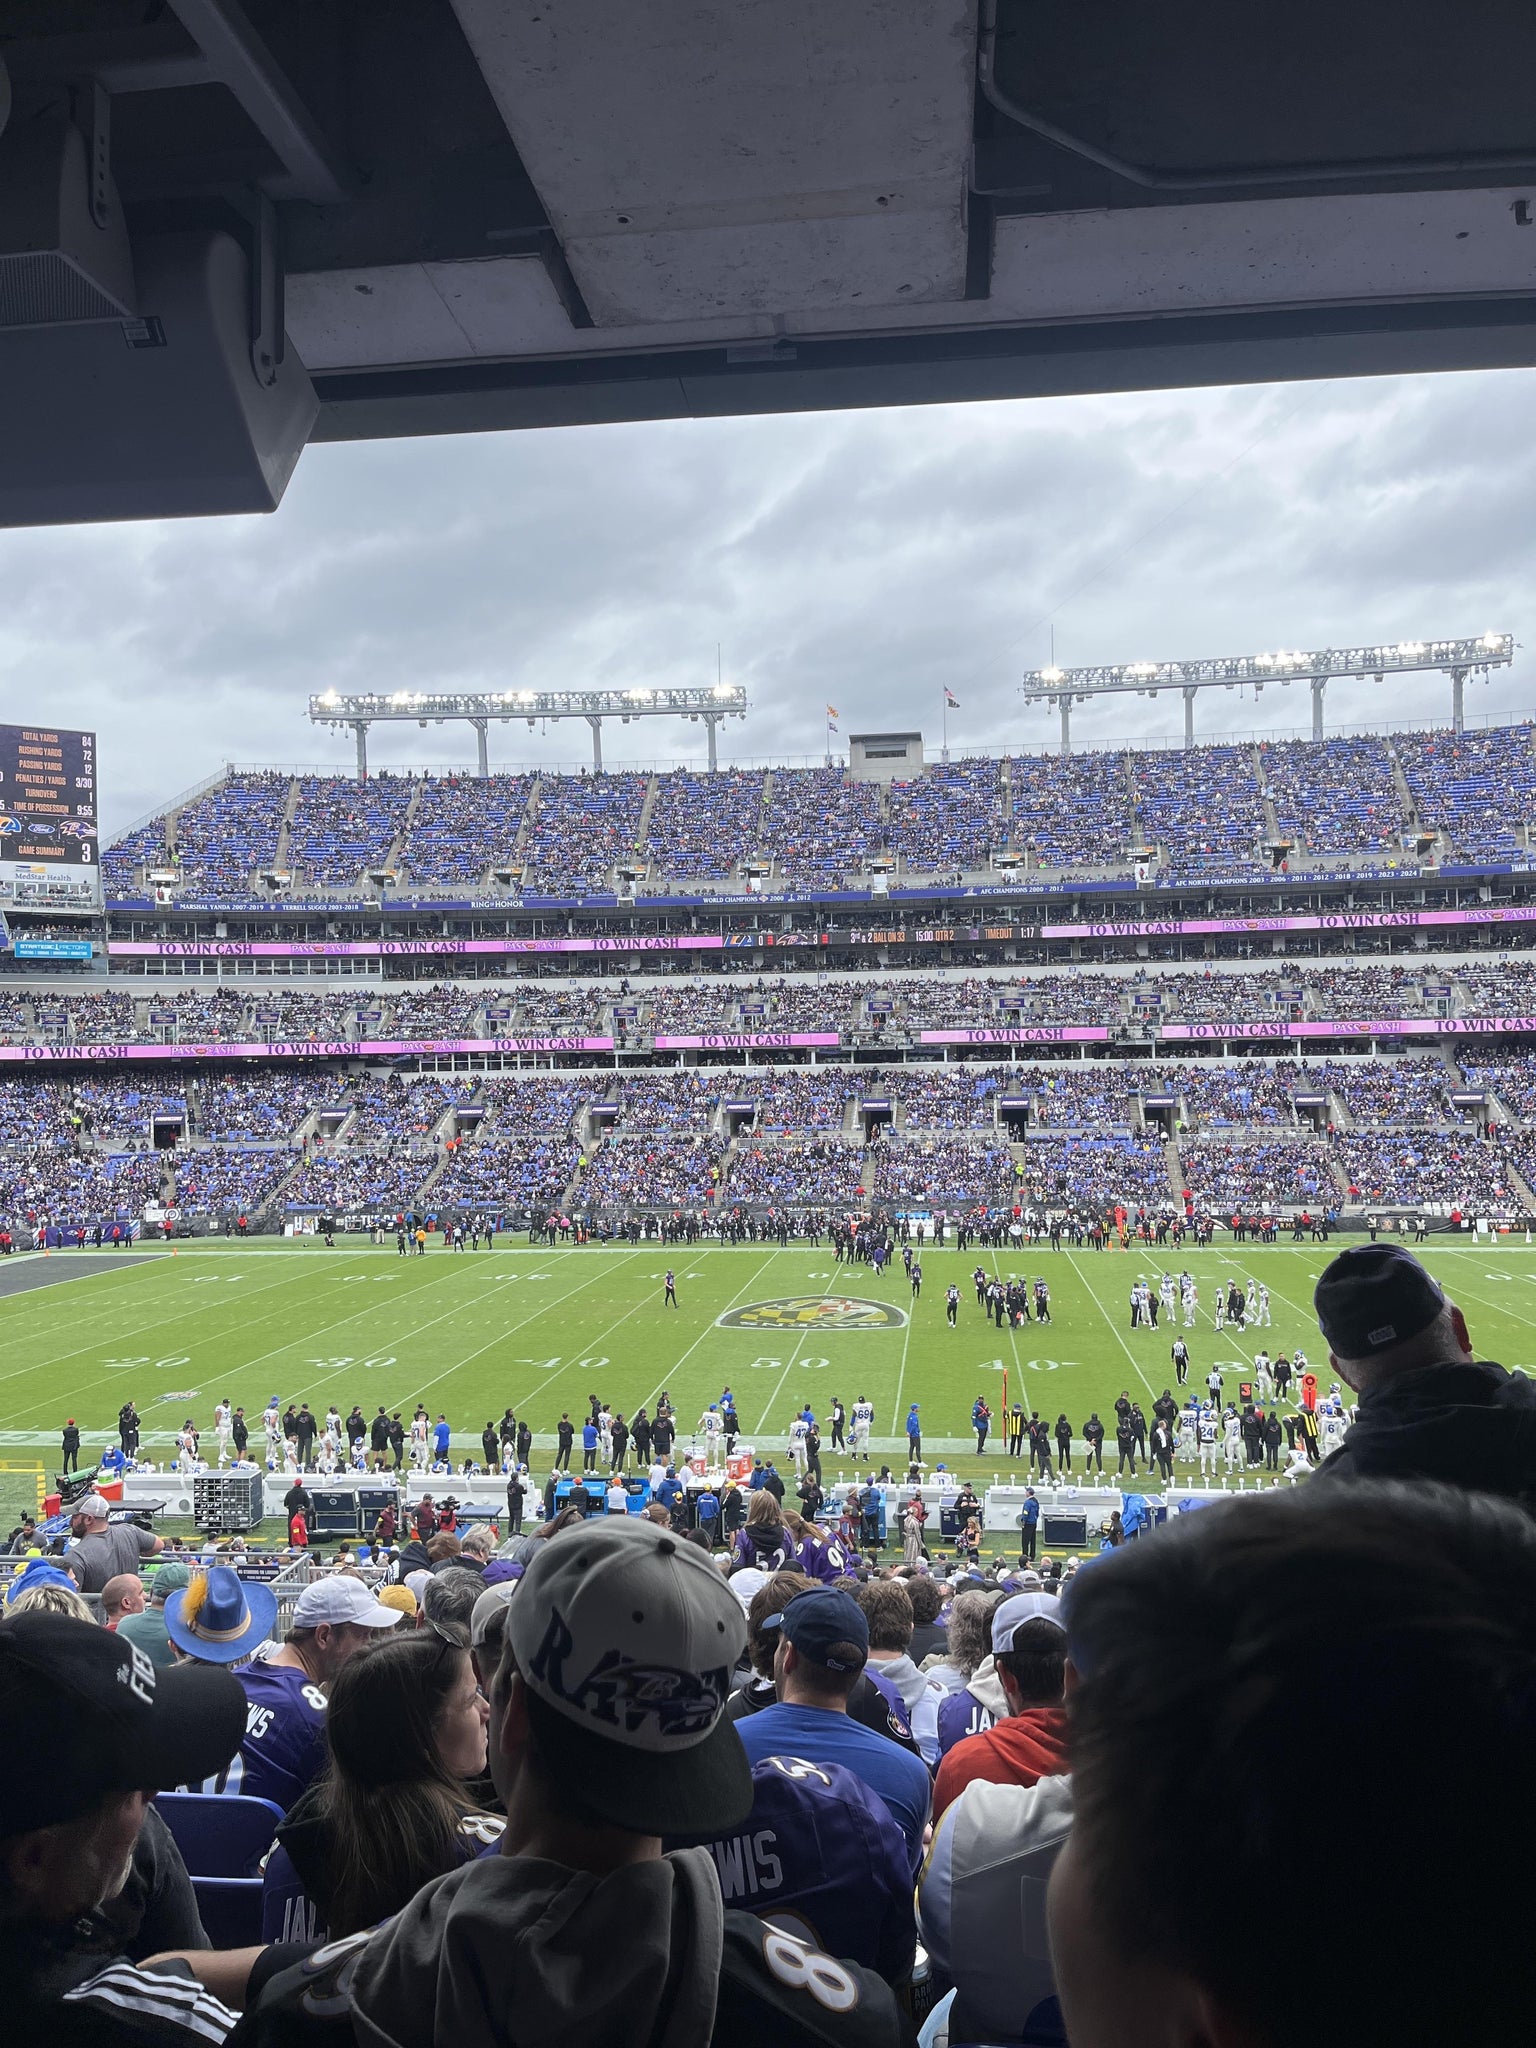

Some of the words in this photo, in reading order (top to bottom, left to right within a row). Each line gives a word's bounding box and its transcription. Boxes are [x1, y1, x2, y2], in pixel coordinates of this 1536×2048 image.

[22, 731, 39, 741] TOTAL
[40, 733, 58, 743] YARDS
[82, 736, 92, 747] 84
[18, 745, 43, 756] RUSHING
[43, 748, 62, 758] YARDS
[83, 750, 92, 761] 72
[19, 760, 43, 770] PASSING
[44, 761, 62, 771] YARDS
[84, 764, 92, 775] 12
[15, 773, 44, 784] PENALTIES
[48, 776, 66, 785] YARDS
[75, 777, 92, 788] 3/30
[25, 788, 57, 799] TURNOVERS
[89, 792, 93, 802] 1
[13, 801, 27, 811] TIME
[27, 803, 35, 811] OF
[35, 803, 69, 813] POSSESSION
[76, 804, 93, 816] 9:55
[18, 845, 35, 855] GAME
[35, 846, 65, 856] SUMMARY
[81, 843, 91, 862] 3
[1511, 863, 1529, 872] THANK
[1188, 879, 1210, 887] NORTH
[1210, 877, 1248, 885] CHAMPIONS
[1249, 876, 1265, 884] 2003
[494, 900, 524, 908] HONOR
[1465, 911, 1493, 921] PASS
[1502, 909, 1535, 919] CASH
[1223, 920, 1249, 931] PASS
[1257, 919, 1287, 929] CASH
[1317, 916, 1338, 928] TO
[1342, 915, 1375, 927] WIN
[1379, 914, 1420, 925] CASH
[985, 928, 1013, 940] TIMEOUT
[1020, 926, 1035, 938] 1:17
[1087, 925, 1107, 936] TO
[1110, 923, 1141, 935] WIN
[1145, 922, 1183, 934] CASH
[758, 935, 764, 946] 0
[812, 934, 818, 945] 3
[850, 932, 861, 944] 3rd
[867, 931, 873, 943] 2
[873, 931, 887, 943] BALL
[887, 931, 897, 943] ON
[897, 931, 905, 943] 33
[915, 930, 933, 942] 15:00
[935, 930, 948, 941] QTR
[949, 929, 955, 941] 2
[156, 943, 176, 954] TO
[180, 944, 211, 954] WIN
[216, 944, 253, 954] CASH
[291, 944, 315, 953] PASS
[323, 945, 350, 954] CASH
[377, 942, 395, 953] TO
[395, 942, 428, 953] WIN
[431, 942, 466, 953] CASH
[504, 942, 526, 951] PASS
[535, 941, 561, 951] CASH
[591, 939, 609, 950] TO
[614, 939, 641, 949] WIN
[644, 938, 679, 949] CASH
[1186, 1025, 1207, 1037] TO
[1211, 1025, 1244, 1036] WIN
[1249, 1024, 1290, 1036] CASH
[1332, 1024, 1360, 1033] PASS
[1369, 1022, 1402, 1032] CASH
[1434, 1021, 1457, 1032] TO
[1462, 1020, 1497, 1031] WIN
[1501, 1018, 1536, 1031] CAS
[699, 1036, 718, 1047] TO
[721, 1035, 751, 1046] WIN
[755, 1034, 792, 1046] CASH
[966, 1030, 986, 1041] TO
[990, 1030, 1021, 1041] WIN
[1025, 1029, 1064, 1040] CASH
[265, 1044, 286, 1055] TO
[290, 1043, 320, 1054] WIN
[324, 1043, 361, 1054] CASH
[402, 1043, 425, 1052] PASS
[433, 1042, 461, 1051] CASH
[492, 1040, 512, 1050] TO
[515, 1039, 545, 1050] WIN
[549, 1039, 585, 1050] CASH
[21, 1047, 44, 1059] TO
[48, 1047, 83, 1058] WIN
[87, 1046, 129, 1058] CASH
[171, 1046, 197, 1055] PASS
[206, 1046, 235, 1055] CASH
[104, 1356, 191, 1367] 20
[316, 1356, 397, 1368] 30
[532, 1357, 610, 1368] 40
[750, 1357, 830, 1368] 50
[978, 1359, 1059, 1371] 40
[1240, 1384, 1251, 1396] 3
[858, 1409, 870, 1419] 69
[707, 1419, 713, 1430] 9
[1183, 1417, 1194, 1427] 25
[1200, 1427, 1213, 1438] 24
[1327, 1424, 1335, 1433] 6
[1297, 1452, 1304, 1460] 2
[694, 1463, 701, 1471] G
[742, 1458, 748, 1466] G
[731, 1463, 738, 1473] G
[755, 1548, 786, 1572] 52
[301, 1684, 328, 1710] 8
[763, 1932, 859, 2013] 8
